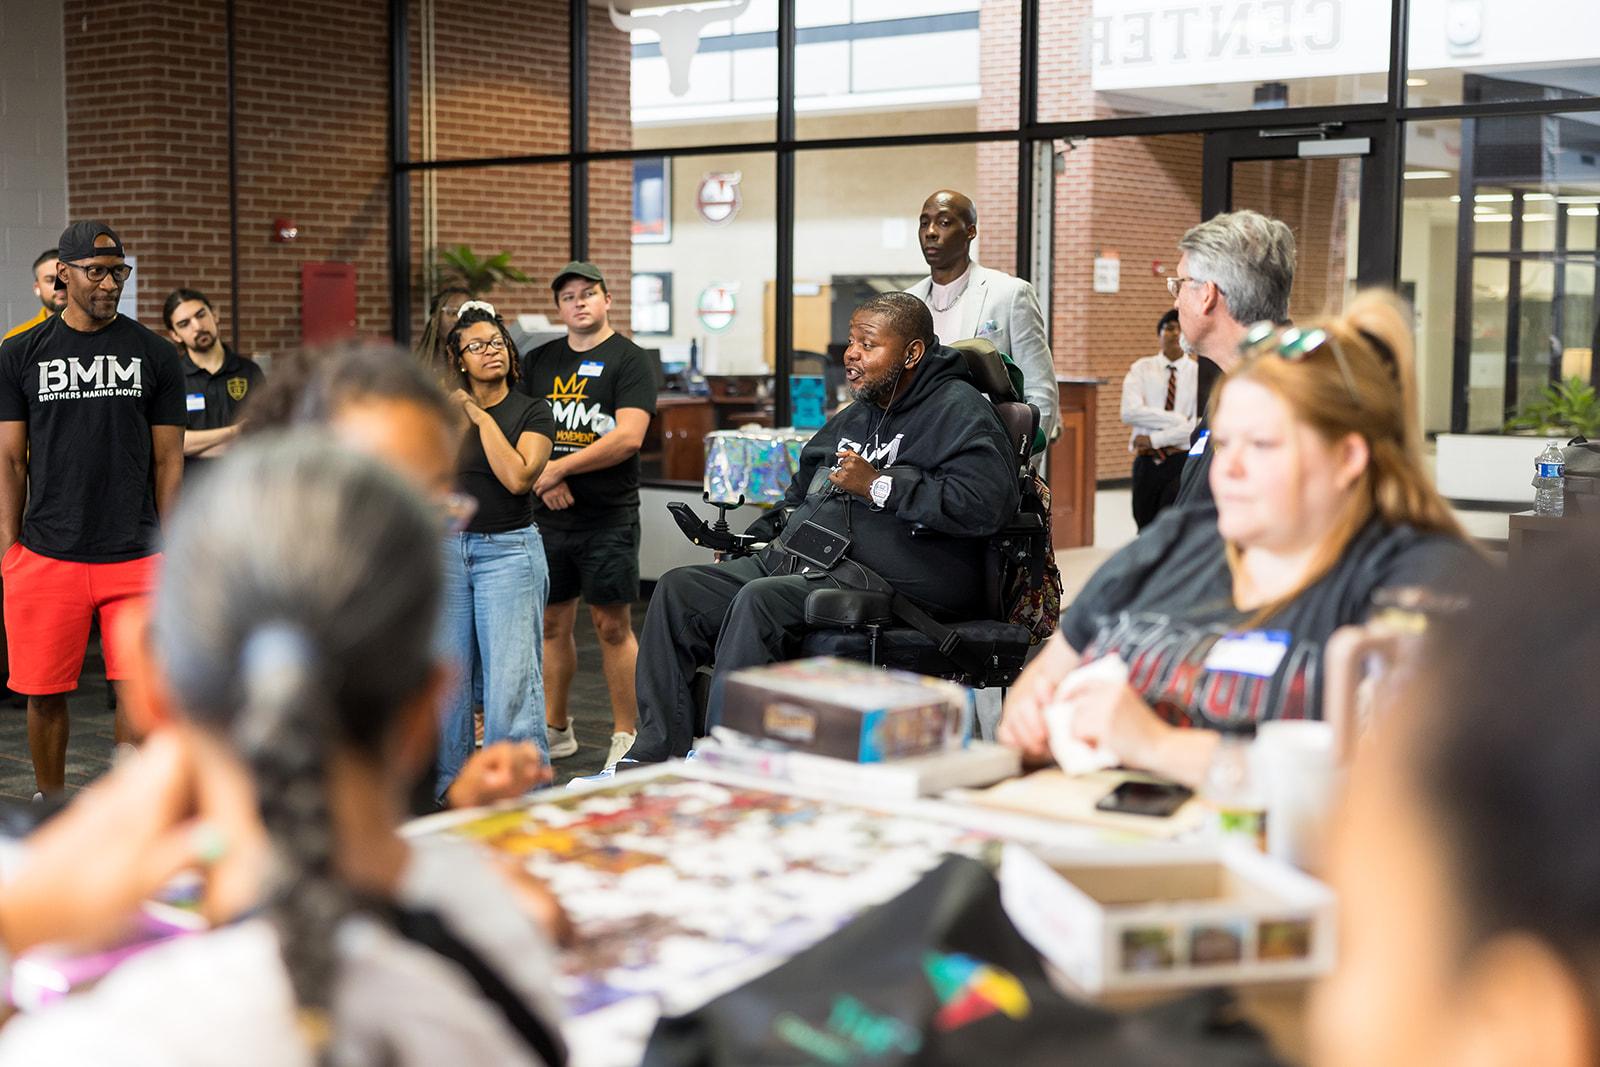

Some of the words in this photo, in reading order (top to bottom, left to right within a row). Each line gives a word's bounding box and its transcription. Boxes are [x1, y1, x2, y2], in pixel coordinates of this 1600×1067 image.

[38, 355, 142, 394] BMM
[38, 391, 81, 402] BROTHERS
[82, 388, 114, 399] MAKING
[115, 388, 142, 398] MOVES
[545, 399, 601, 431] MM
[556, 431, 597, 444] MOVEMENT
